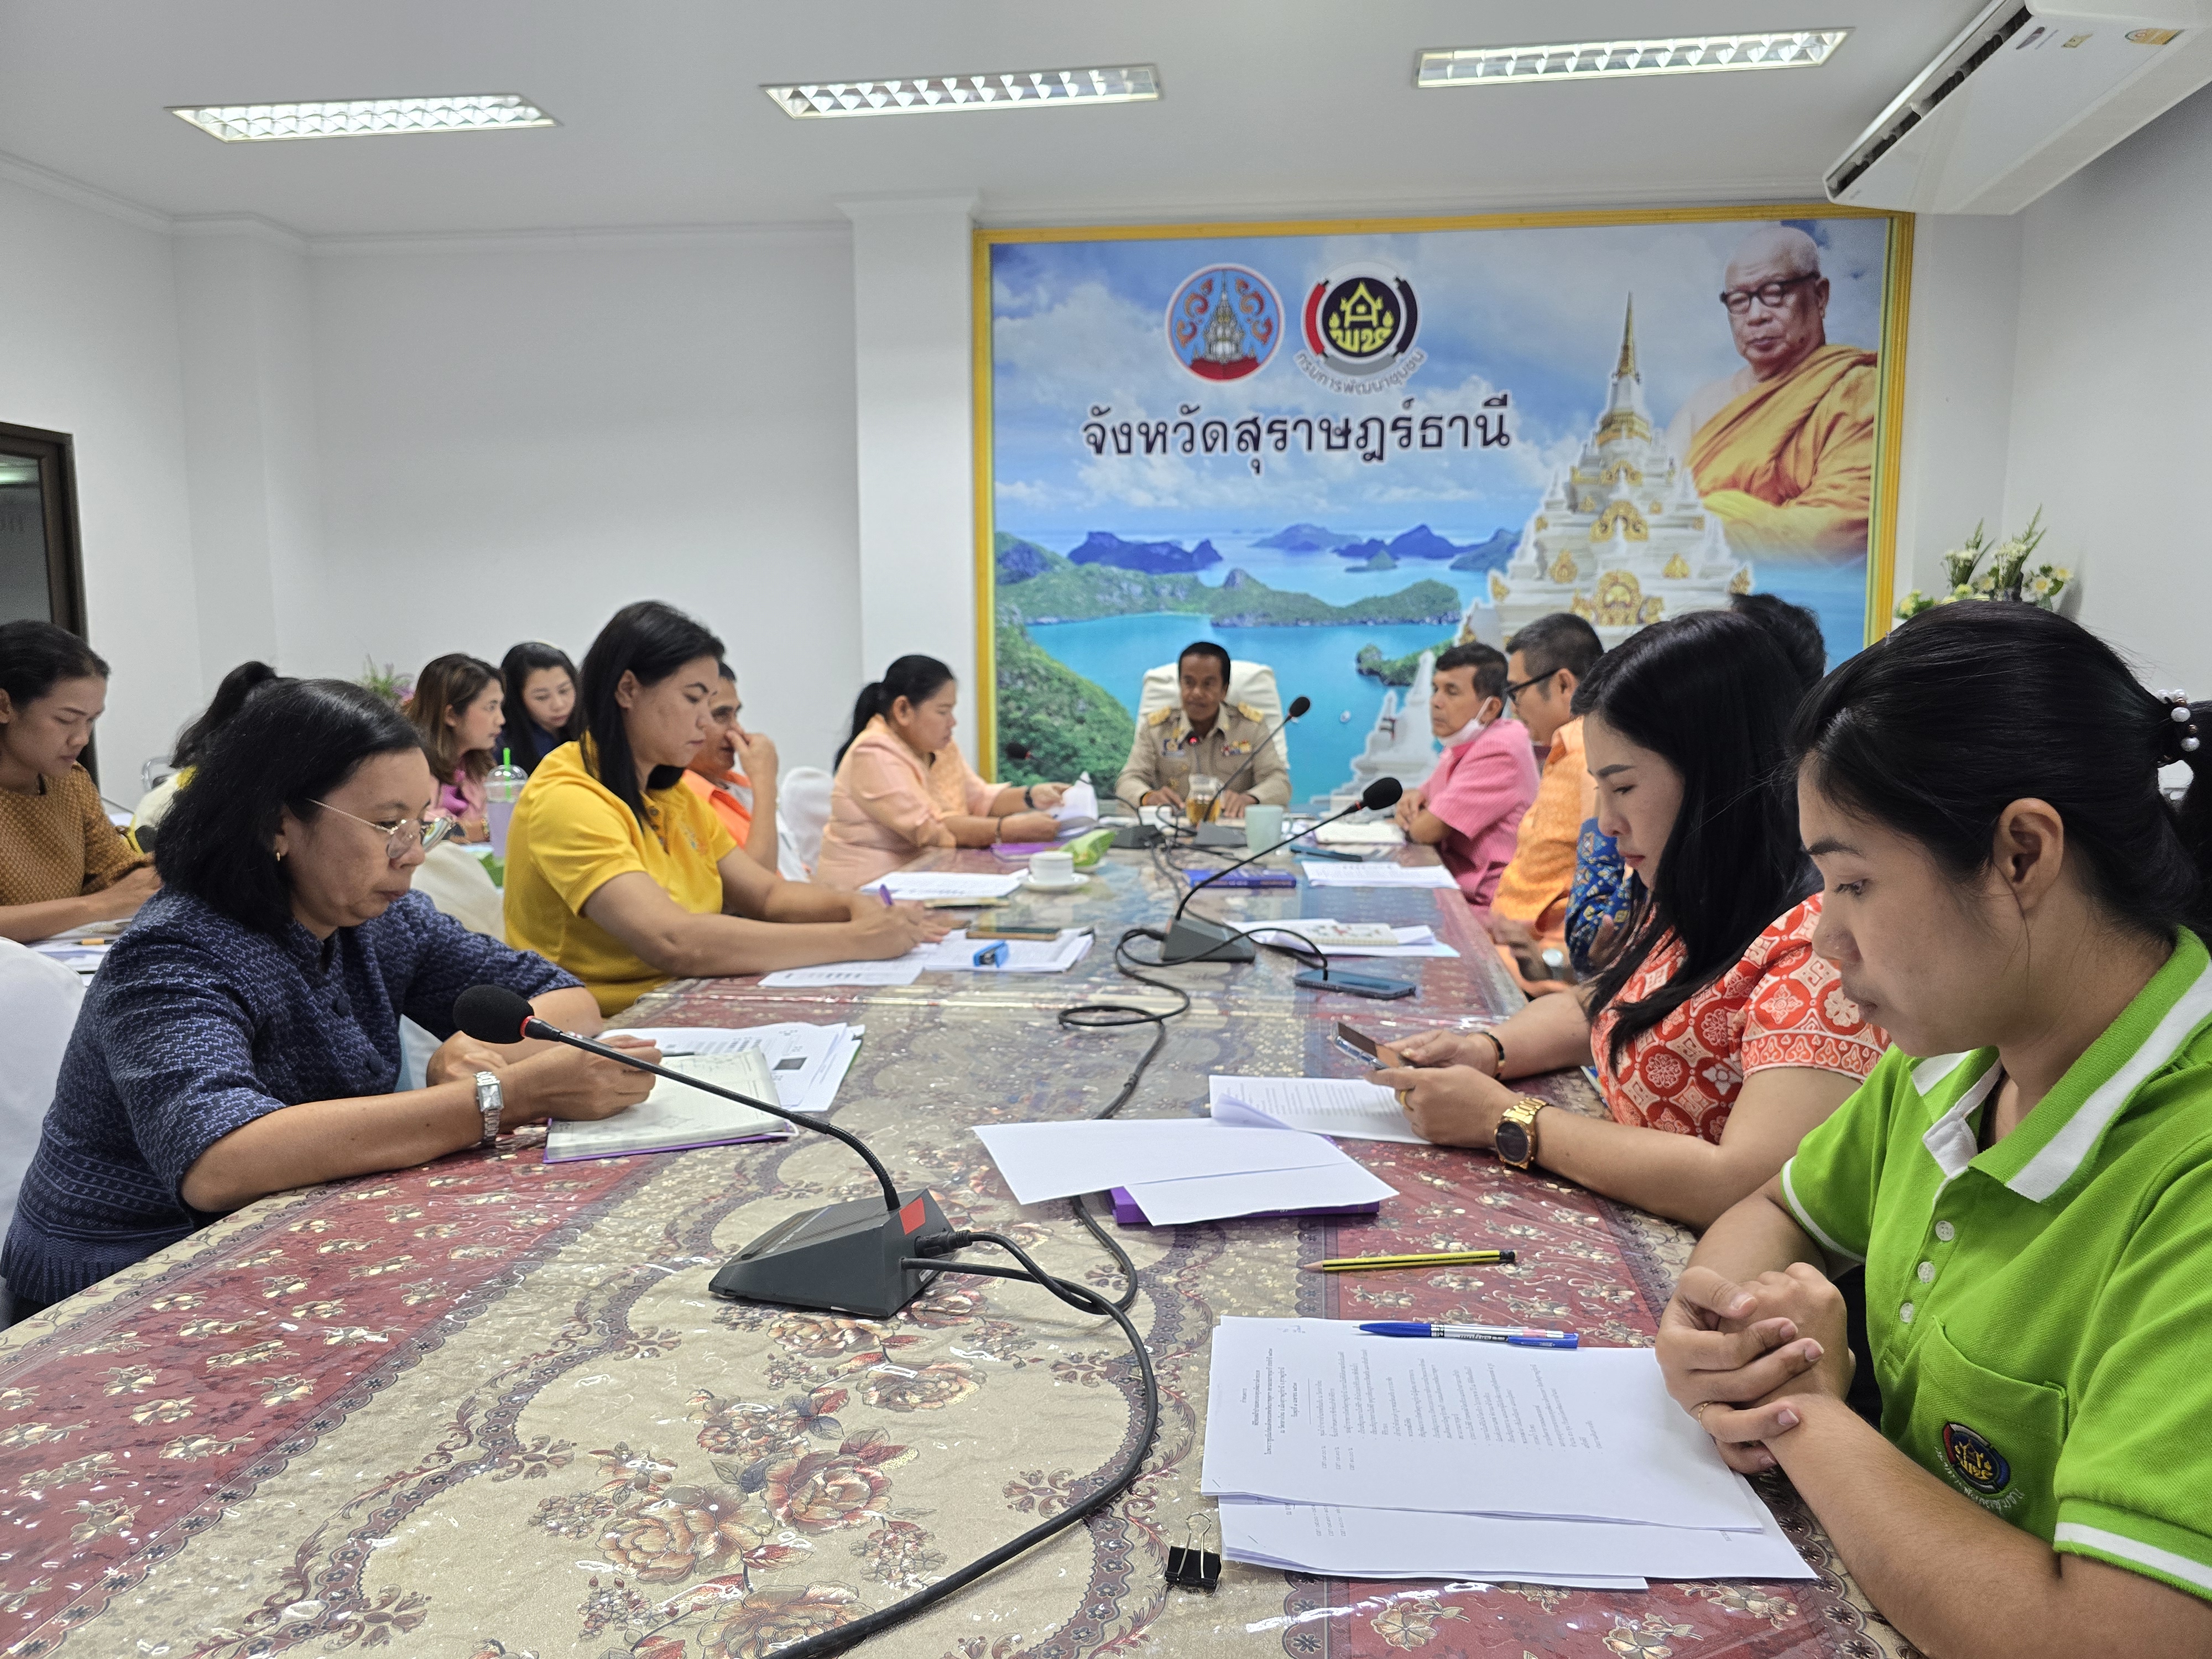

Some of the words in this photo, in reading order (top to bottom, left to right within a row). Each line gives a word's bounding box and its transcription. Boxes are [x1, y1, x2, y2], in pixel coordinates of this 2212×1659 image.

[1297, 348, 1426, 395] กรมการพัฒนาชุมชน
[1083, 394, 1511, 474] จังหวัดสุราษฎร์ธานี
